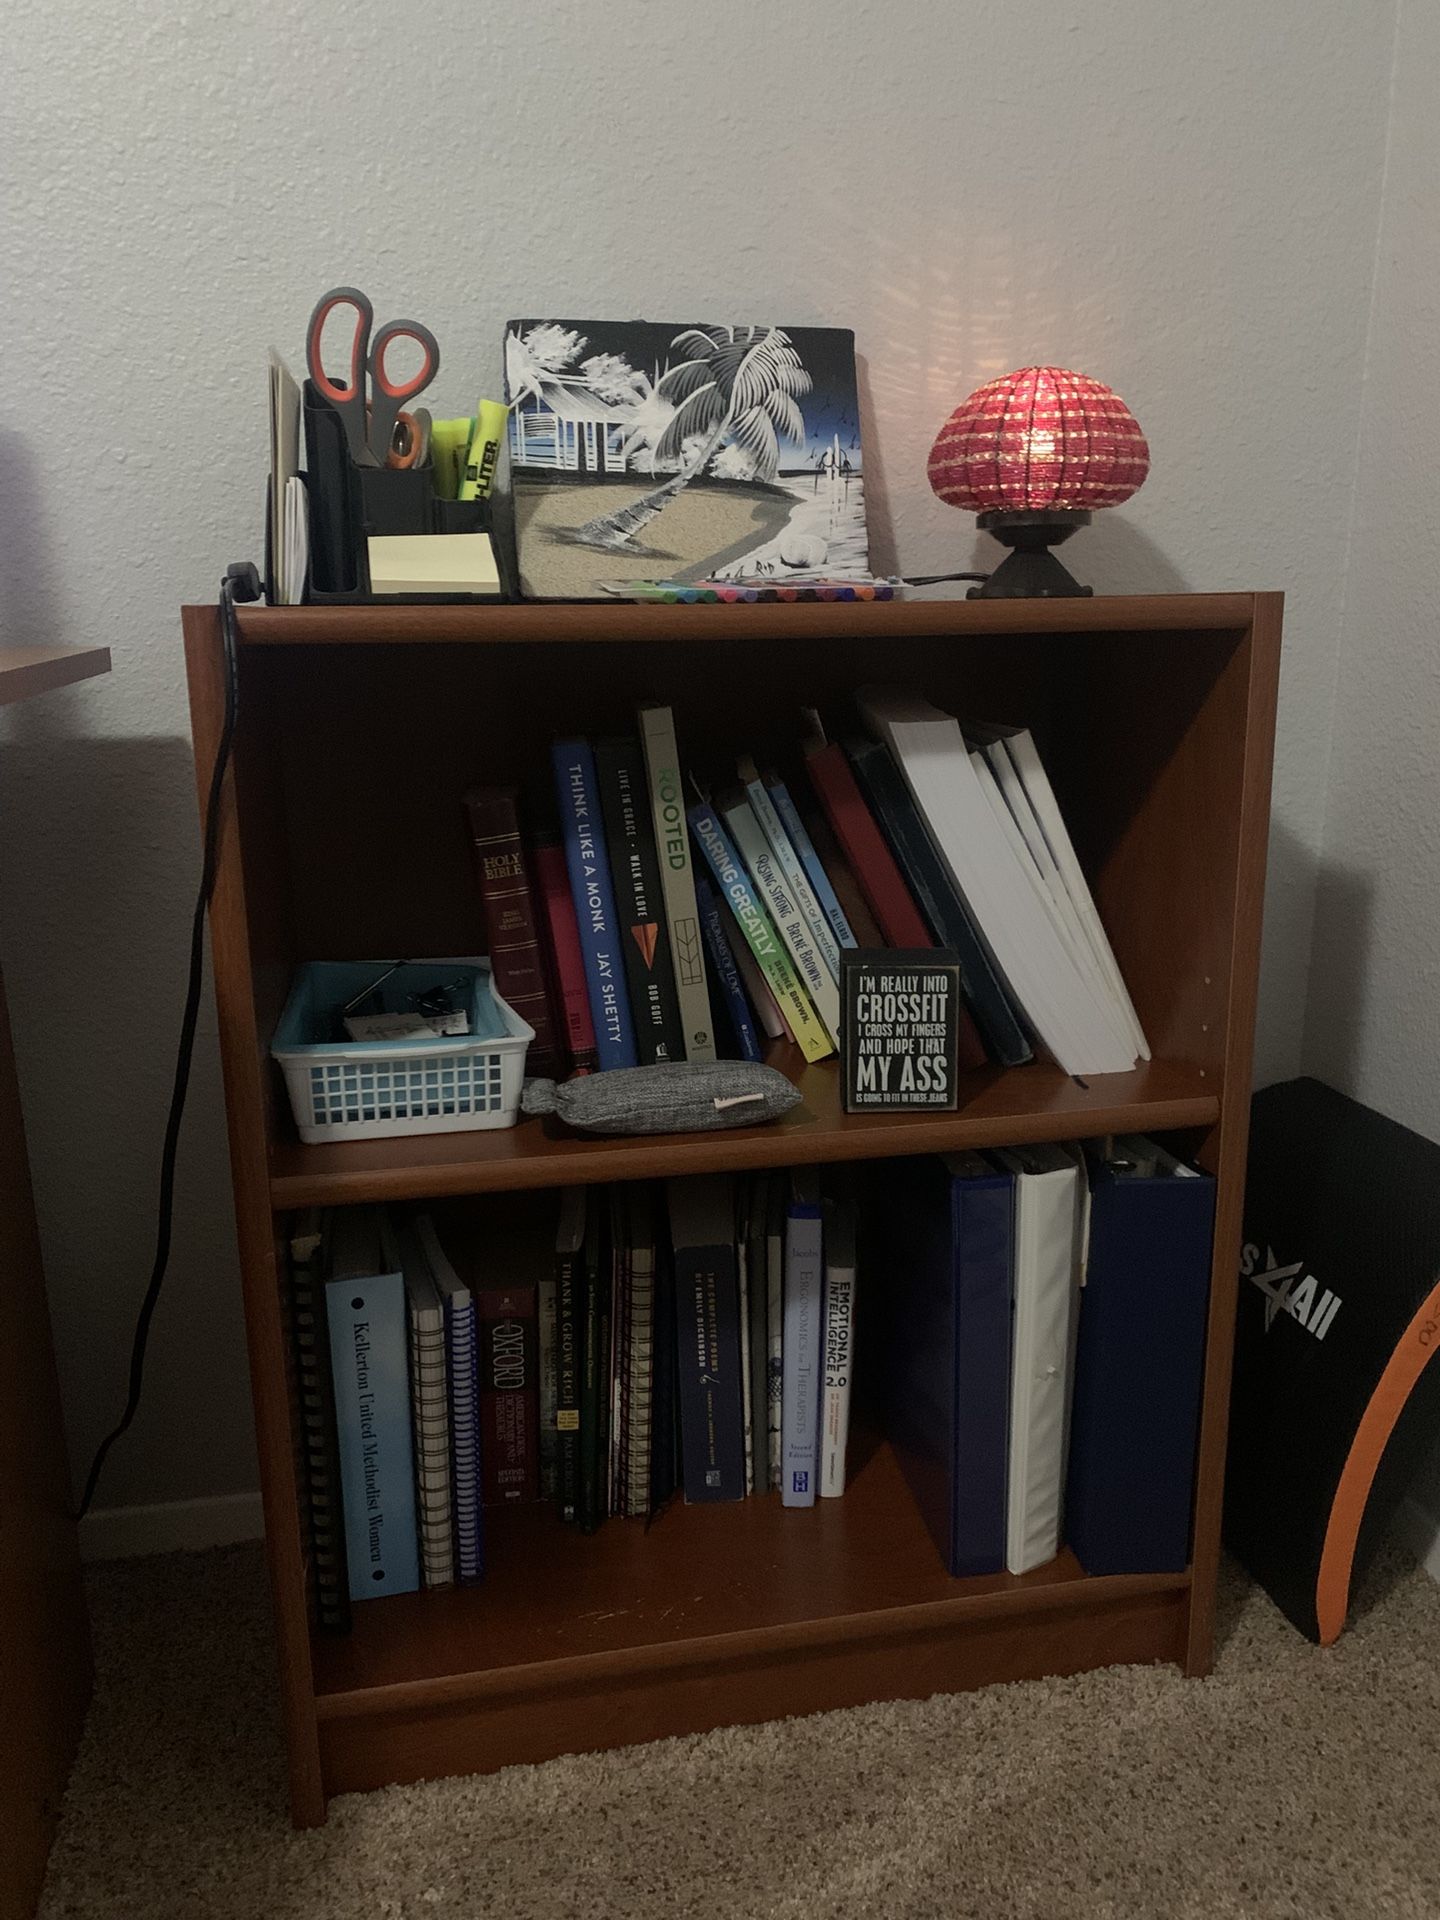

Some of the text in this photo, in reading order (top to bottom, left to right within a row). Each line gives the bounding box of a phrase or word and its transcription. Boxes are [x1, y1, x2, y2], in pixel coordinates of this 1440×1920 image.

[658, 768, 685, 870] ROOTED
[484, 852, 520, 868] HOLY
[569, 764, 606, 933] THINK LIKE A MONK
[618, 769, 648, 917] LIVE IN GRACE WALK IN LOVE
[486, 864, 523, 880] BIBLE
[696, 818, 739, 883] DARING
[730, 884, 776, 955] GREATLY
[756, 854, 794, 918] RISING STRONG
[792, 873, 803, 888] THE
[799, 888, 813, 910] GIFTS
[808, 908, 817, 919] OF
[829, 909, 849, 941] HAL ELROD
[786, 922, 822, 984] BRENÉ BROWN
[774, 961, 791, 991] BRENÉ
[859, 975, 948, 993] I'M REALLY INTO
[597, 952, 622, 1043] JAY SHETTY
[648, 984, 663, 1025] BOB GOFF
[857, 993, 948, 1022] CROSSFIT
[858, 1023, 946, 1037] I CROSS MY FINGERS
[858, 1038, 946, 1054] AND HOPE THAT
[856, 1055, 948, 1092] MY ASS
[856, 1093, 863, 1103] IS
[561, 1263, 573, 1305] THANK
[695, 1287, 704, 1313] EMILY
[562, 1310, 571, 1319] &
[826, 1281, 839, 1372] INTELLIGENCE
[837, 1281, 850, 1373] EMOTIONAL
[492, 1324, 525, 1389] OXFORD
[562, 1322, 573, 1363] GROW
[697, 1317, 706, 1368] DICKINSON
[710, 1342, 719, 1372] POEMS
[562, 1369, 573, 1405] RICH
[826, 1376, 847, 1388] 2.0
[354, 1323, 384, 1561] Kellerton United Methodist Women
